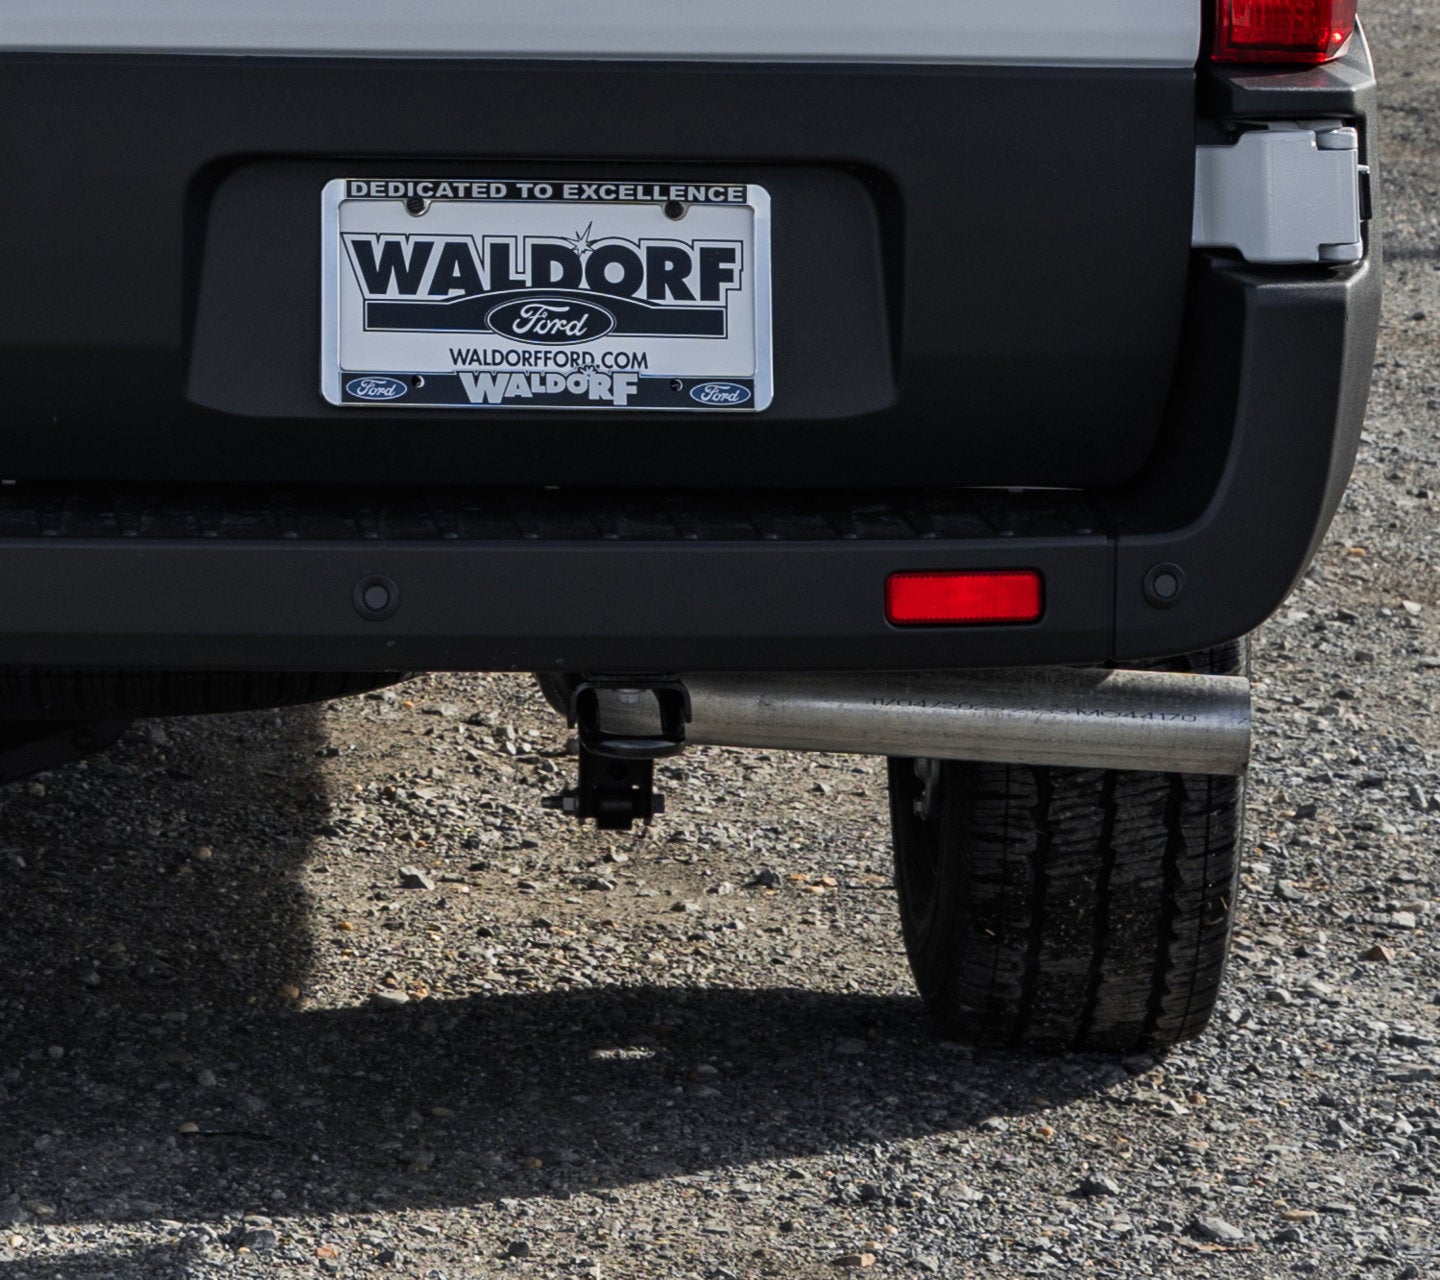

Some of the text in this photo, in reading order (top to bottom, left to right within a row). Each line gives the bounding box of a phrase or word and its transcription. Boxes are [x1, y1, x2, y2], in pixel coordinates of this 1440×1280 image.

[350, 182, 744, 203] DEDICATED TO EXCELLENCE
[346, 236, 742, 302] WALDORF
[513, 303, 588, 337] Ford
[449, 348, 648, 370] WALDORFFORD.COM
[356, 380, 396, 398] Ford
[458, 371, 639, 406] WALDORF
[701, 384, 740, 403] Ford
